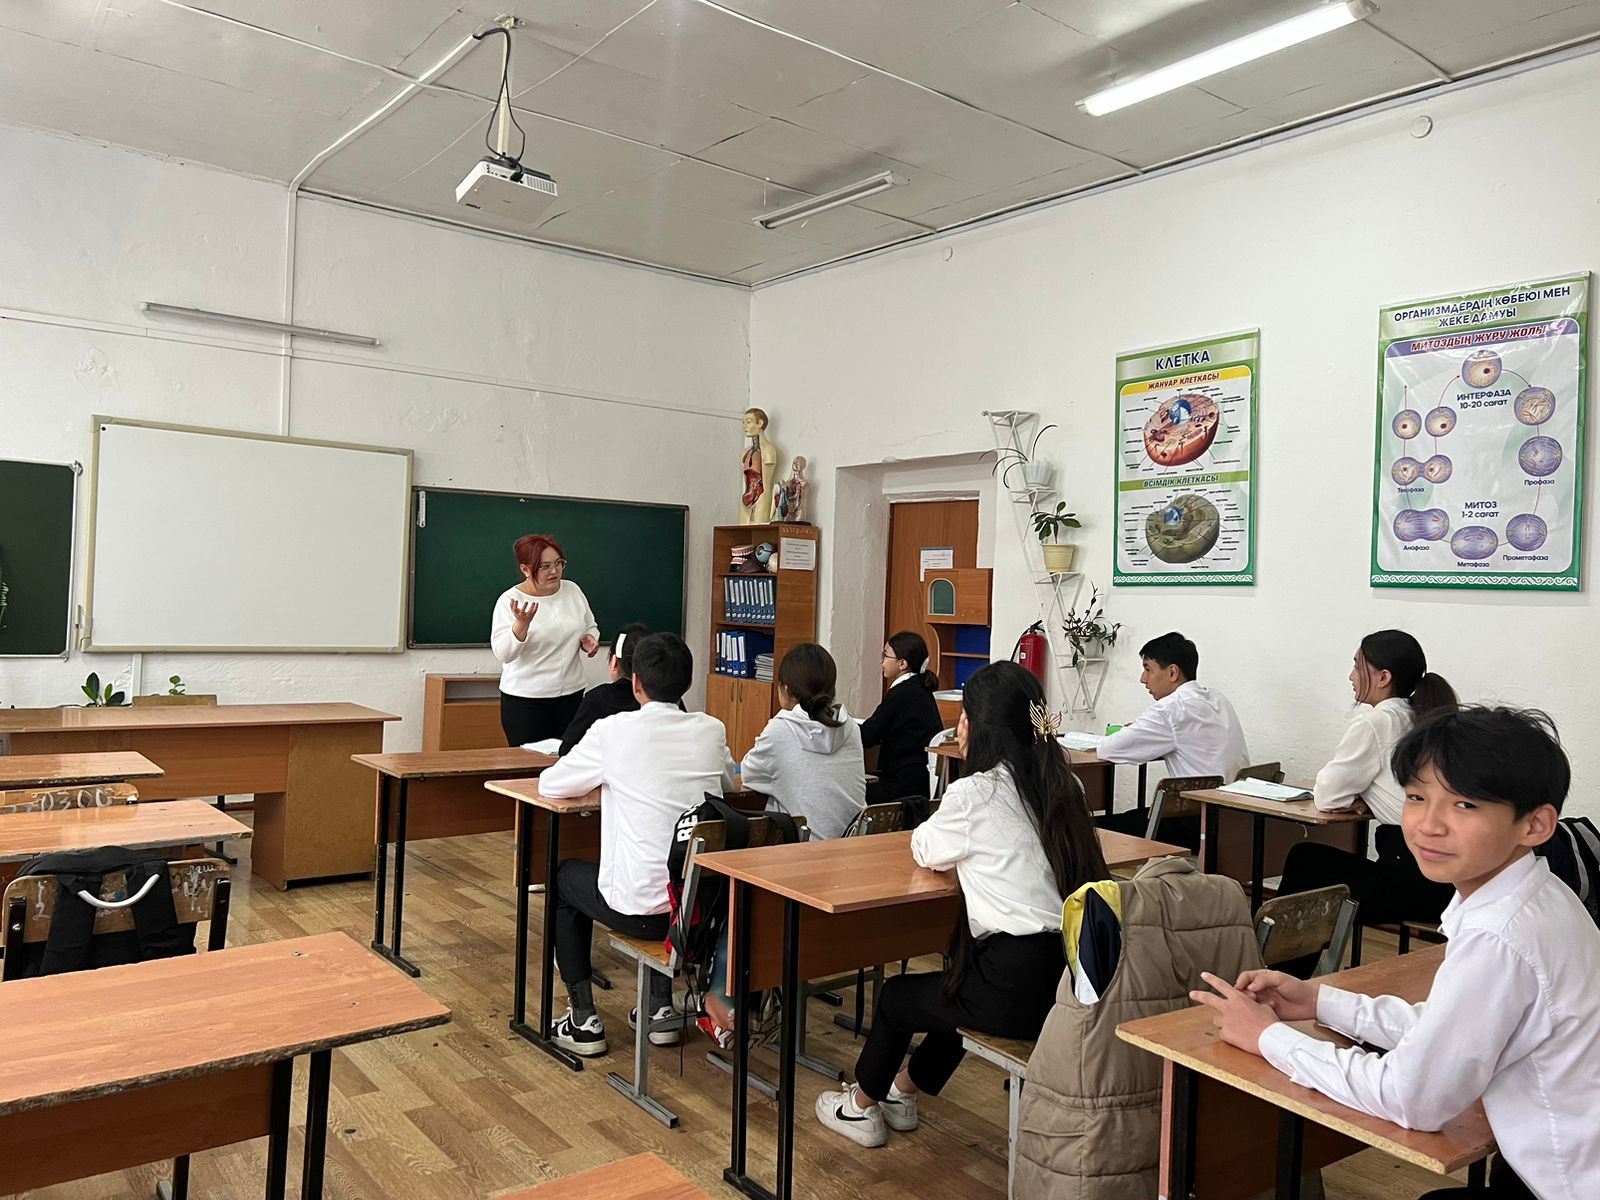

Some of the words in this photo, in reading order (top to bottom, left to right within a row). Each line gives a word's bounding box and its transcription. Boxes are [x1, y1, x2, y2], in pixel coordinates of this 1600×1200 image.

[1543, 286, 1571, 299] МЕН
[1438, 314, 1470, 327] ЖЕКЕ
[1155, 350, 1210, 370] КЛЕТКА
[1147, 379, 1178, 390] ЖАНУАР
[1179, 372, 1220, 385] КЛЕТКАСЫ
[1456, 389, 1511, 400] ИНТЕРФАЗА
[1460, 400, 1482, 409] 10-20
[1177, 474, 1219, 485] КЛЕТКАСЫ
[1523, 478, 1556, 487] Профаза
[1464, 500, 1497, 509] МИТОЗ
[1461, 510, 1473, 518] 1-2
[1502, 554, 1549, 562] Прометафаза
